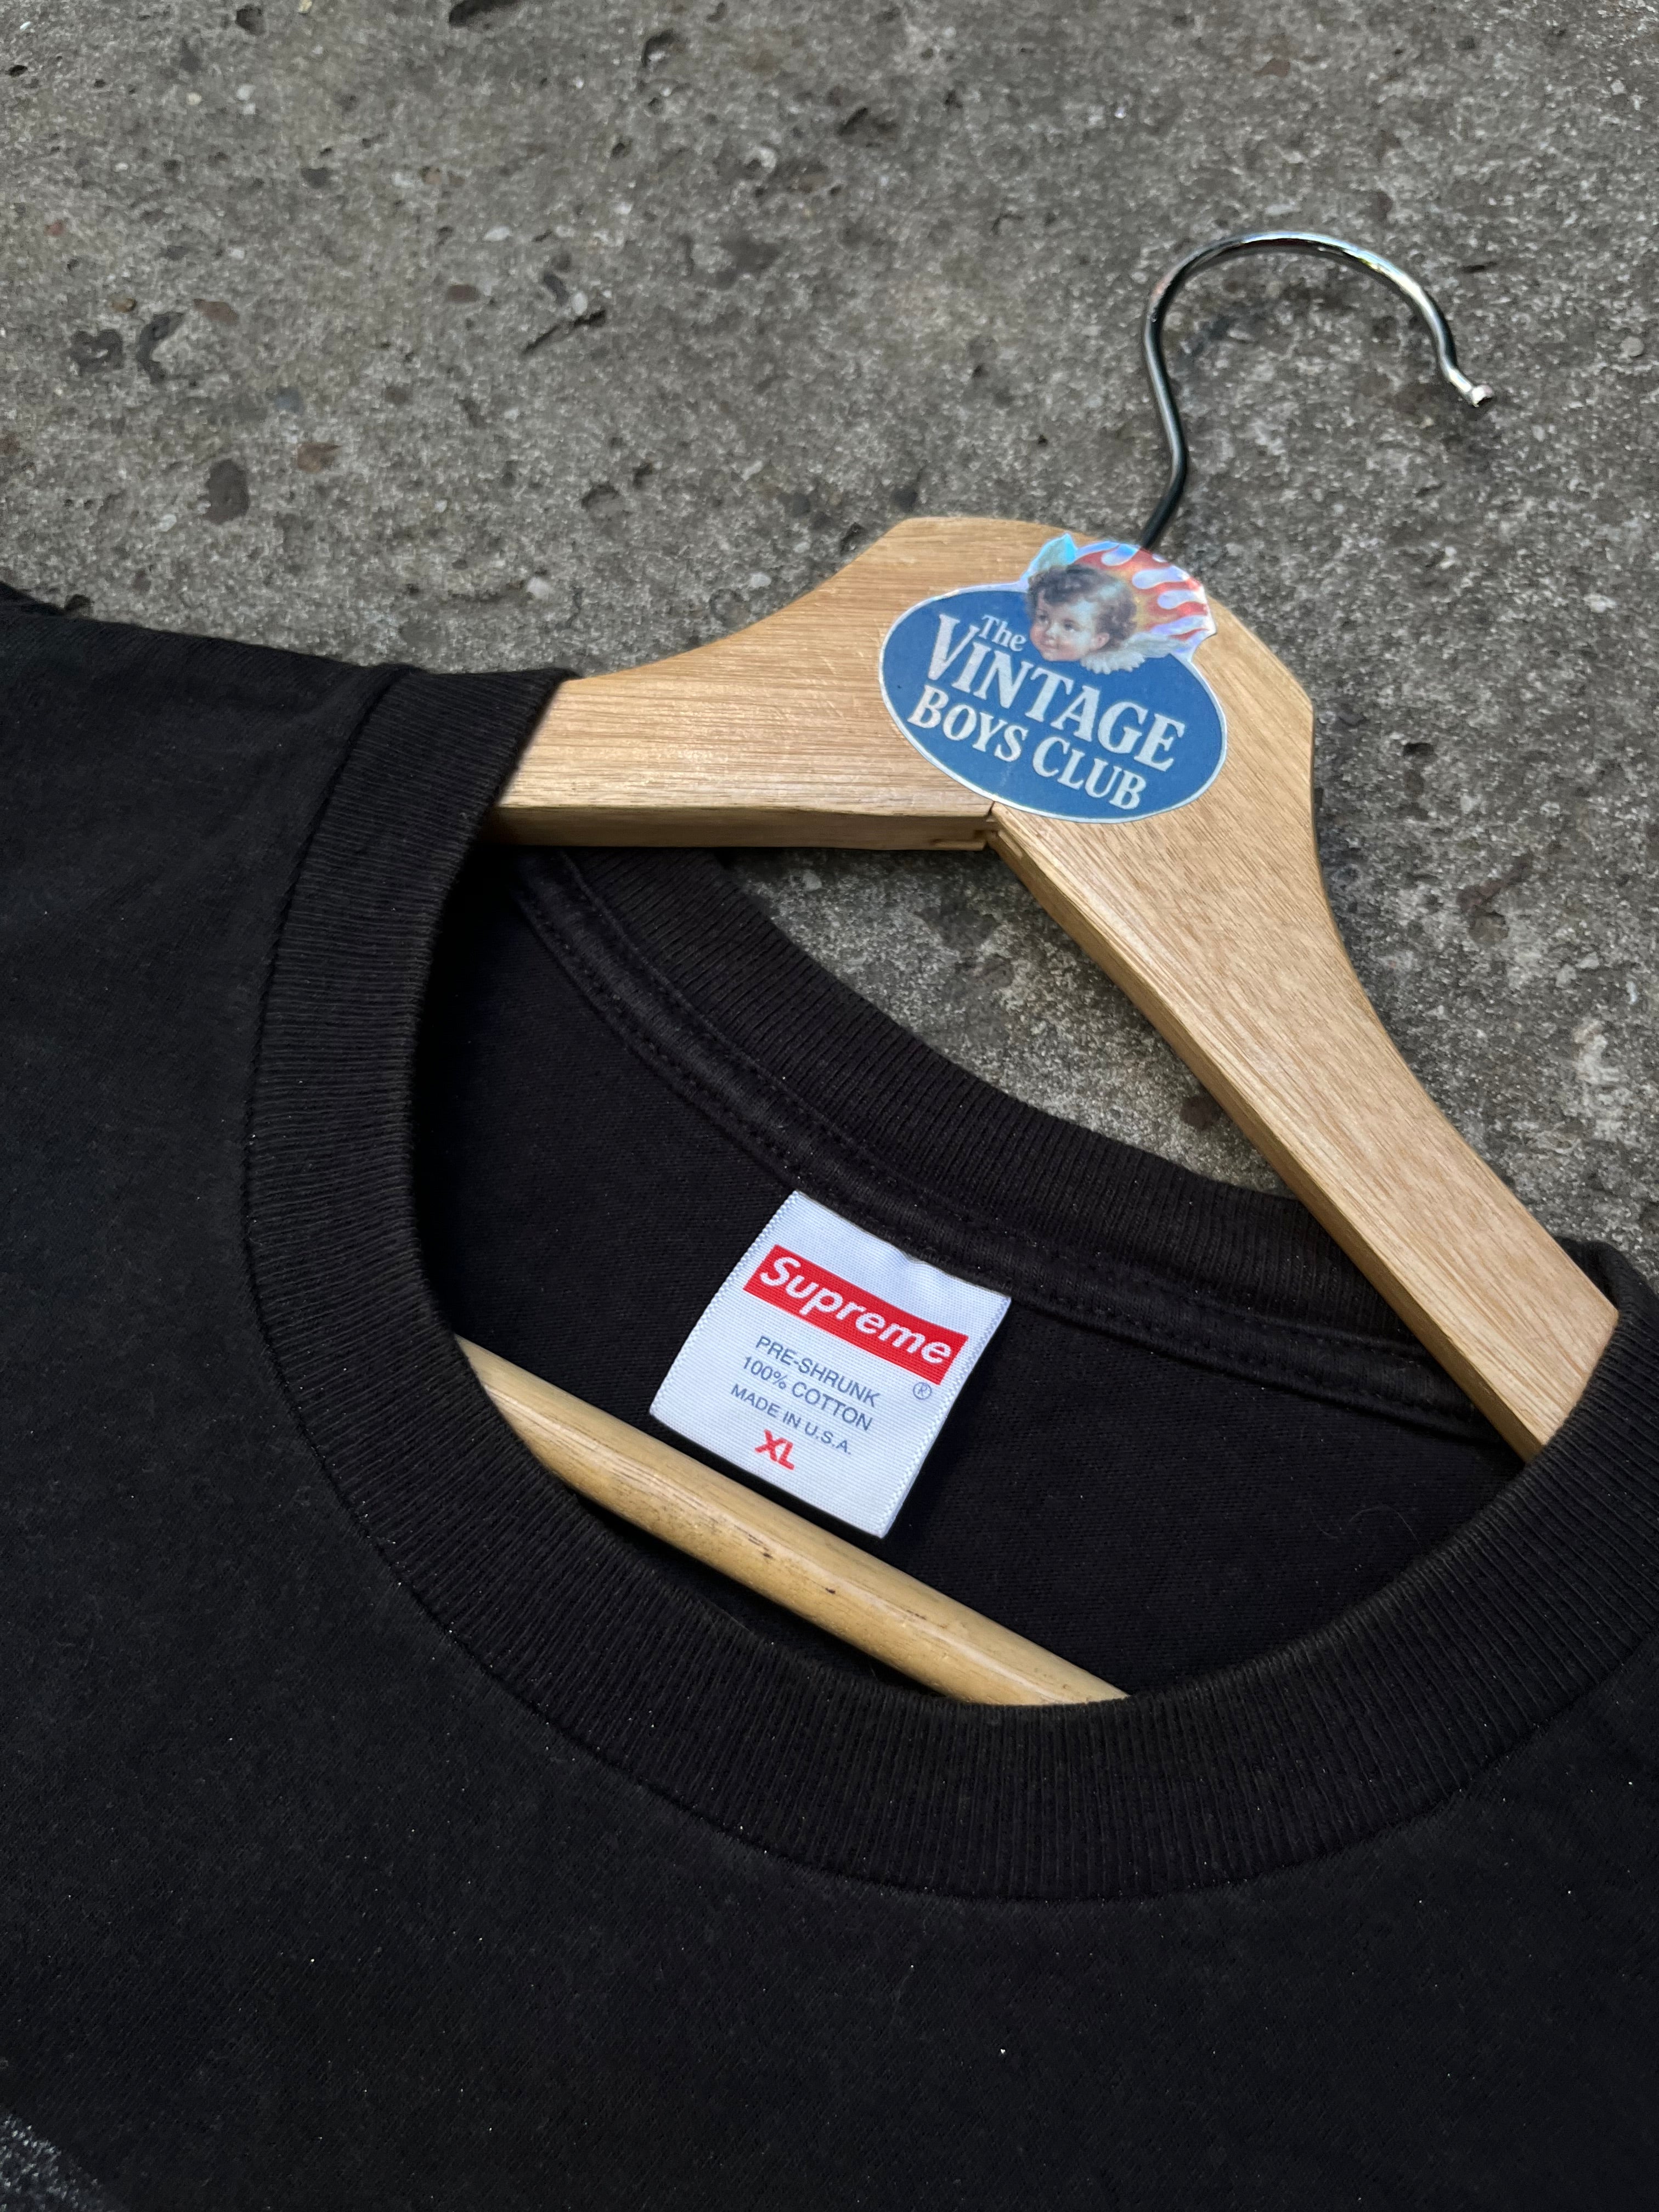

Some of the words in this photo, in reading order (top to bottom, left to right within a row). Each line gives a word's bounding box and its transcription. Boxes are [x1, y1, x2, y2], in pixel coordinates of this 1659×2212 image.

[981, 614, 1027, 653] The
[927, 613, 1186, 772] VINTAGE
[907, 684, 1029, 763] BOYS
[1032, 735, 1148, 811] CLUB
[759, 1255, 951, 1365] Supreme
[742, 1356, 787, 1391] 100%
[791, 1381, 873, 1431] COTTON
[754, 1335, 881, 1409] PRE-SHRUNK
[730, 1383, 781, 1419] MADE
[782, 1410, 802, 1430] IN
[804, 1420, 852, 1455] U.S.A.
[754, 1428, 795, 1471] XL
